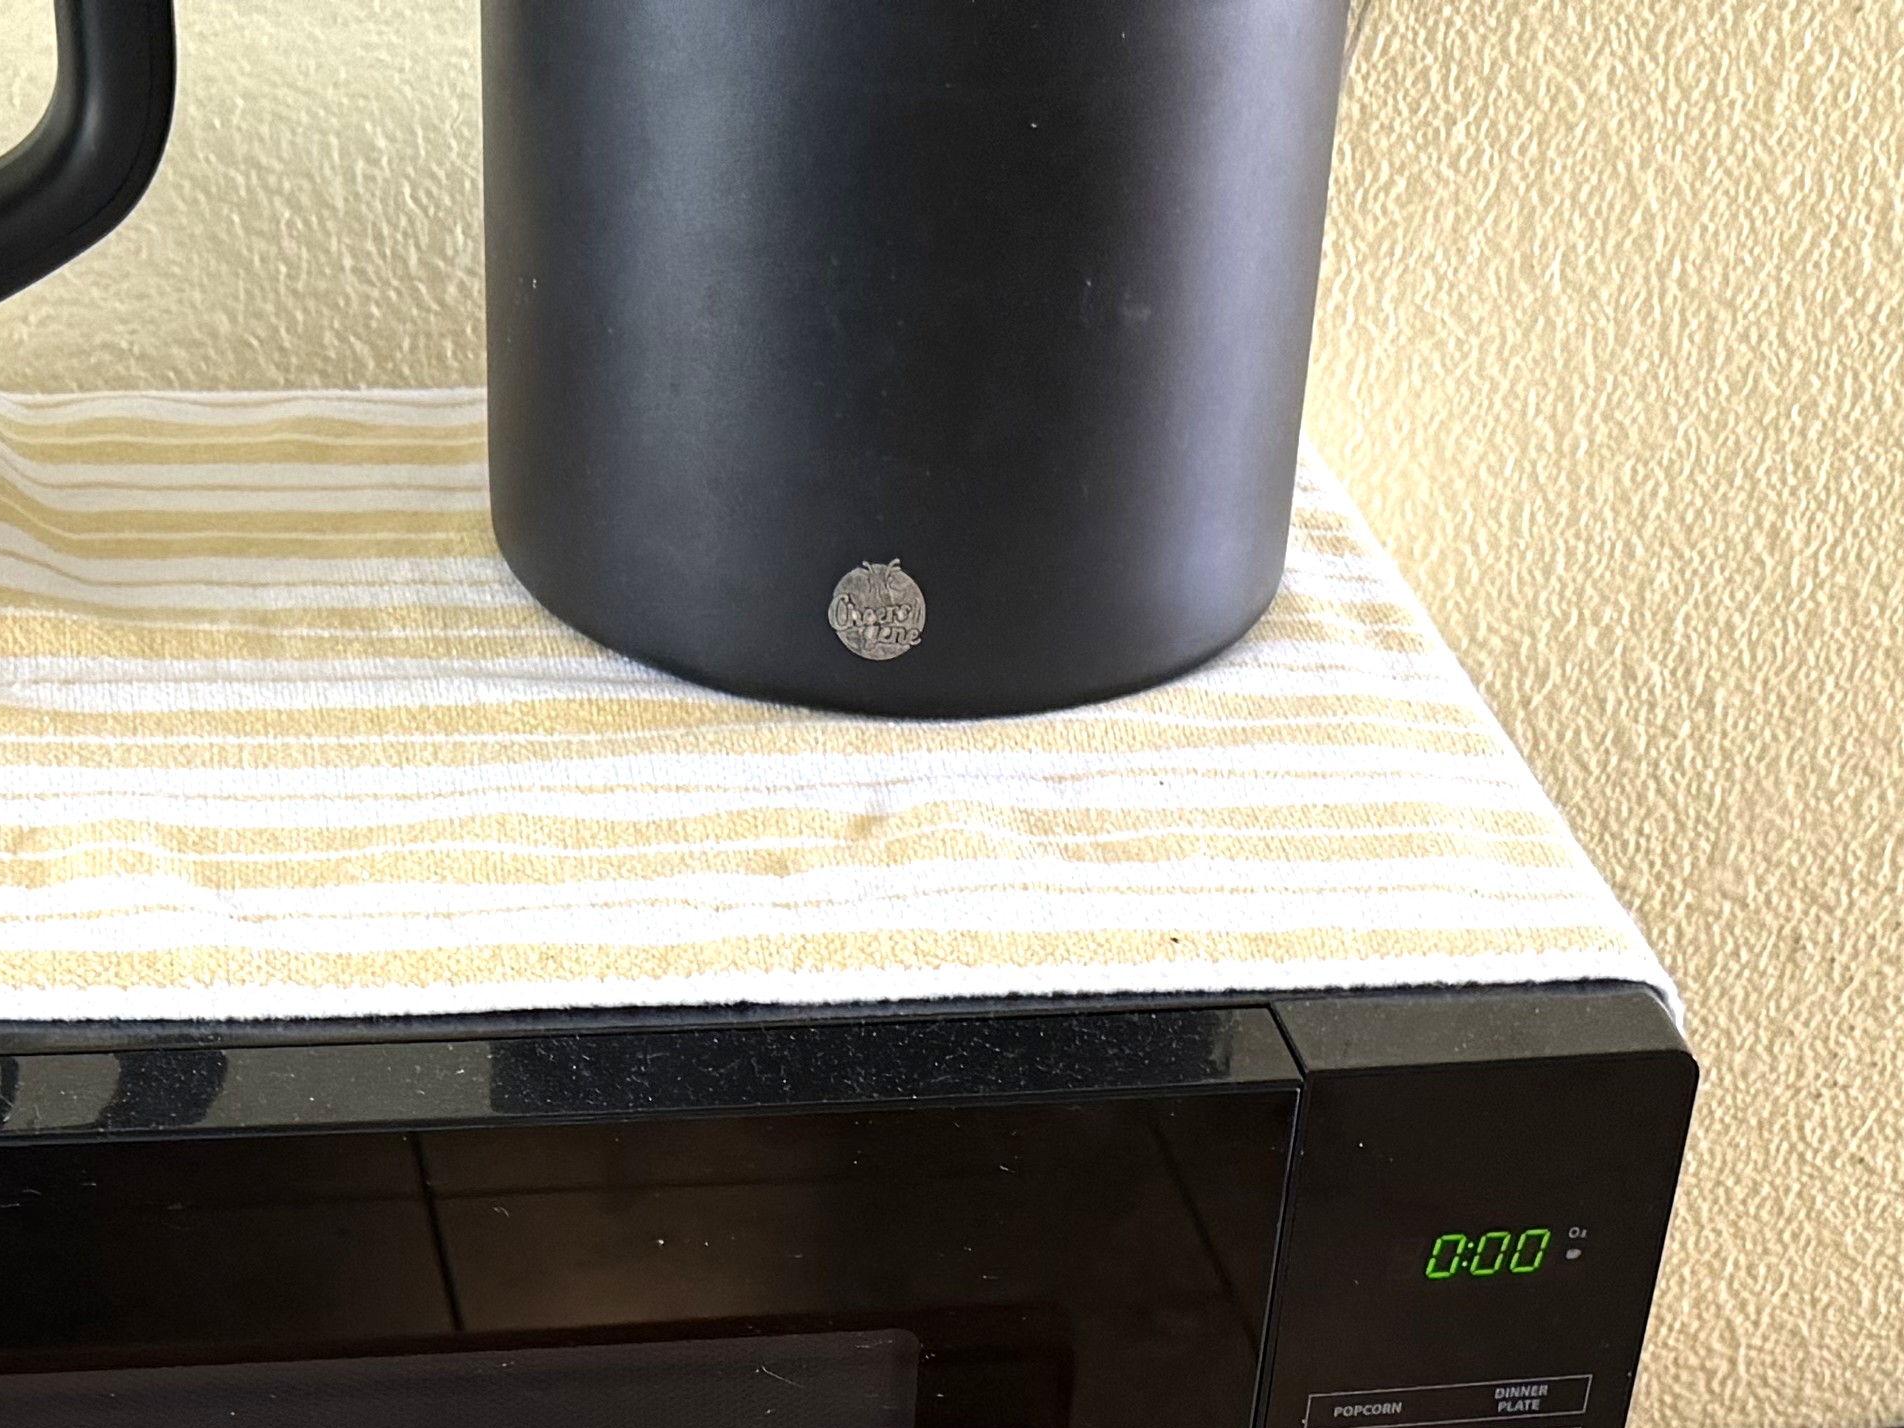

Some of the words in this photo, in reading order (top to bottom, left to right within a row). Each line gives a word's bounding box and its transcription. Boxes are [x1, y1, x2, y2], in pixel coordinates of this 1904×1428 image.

[1425, 1229, 1551, 1279] 0:00
[1494, 1385, 1549, 1399] DINNER
[1333, 1402, 1403, 1418] POPCORN
[1497, 1399, 1541, 1413] PLATE
